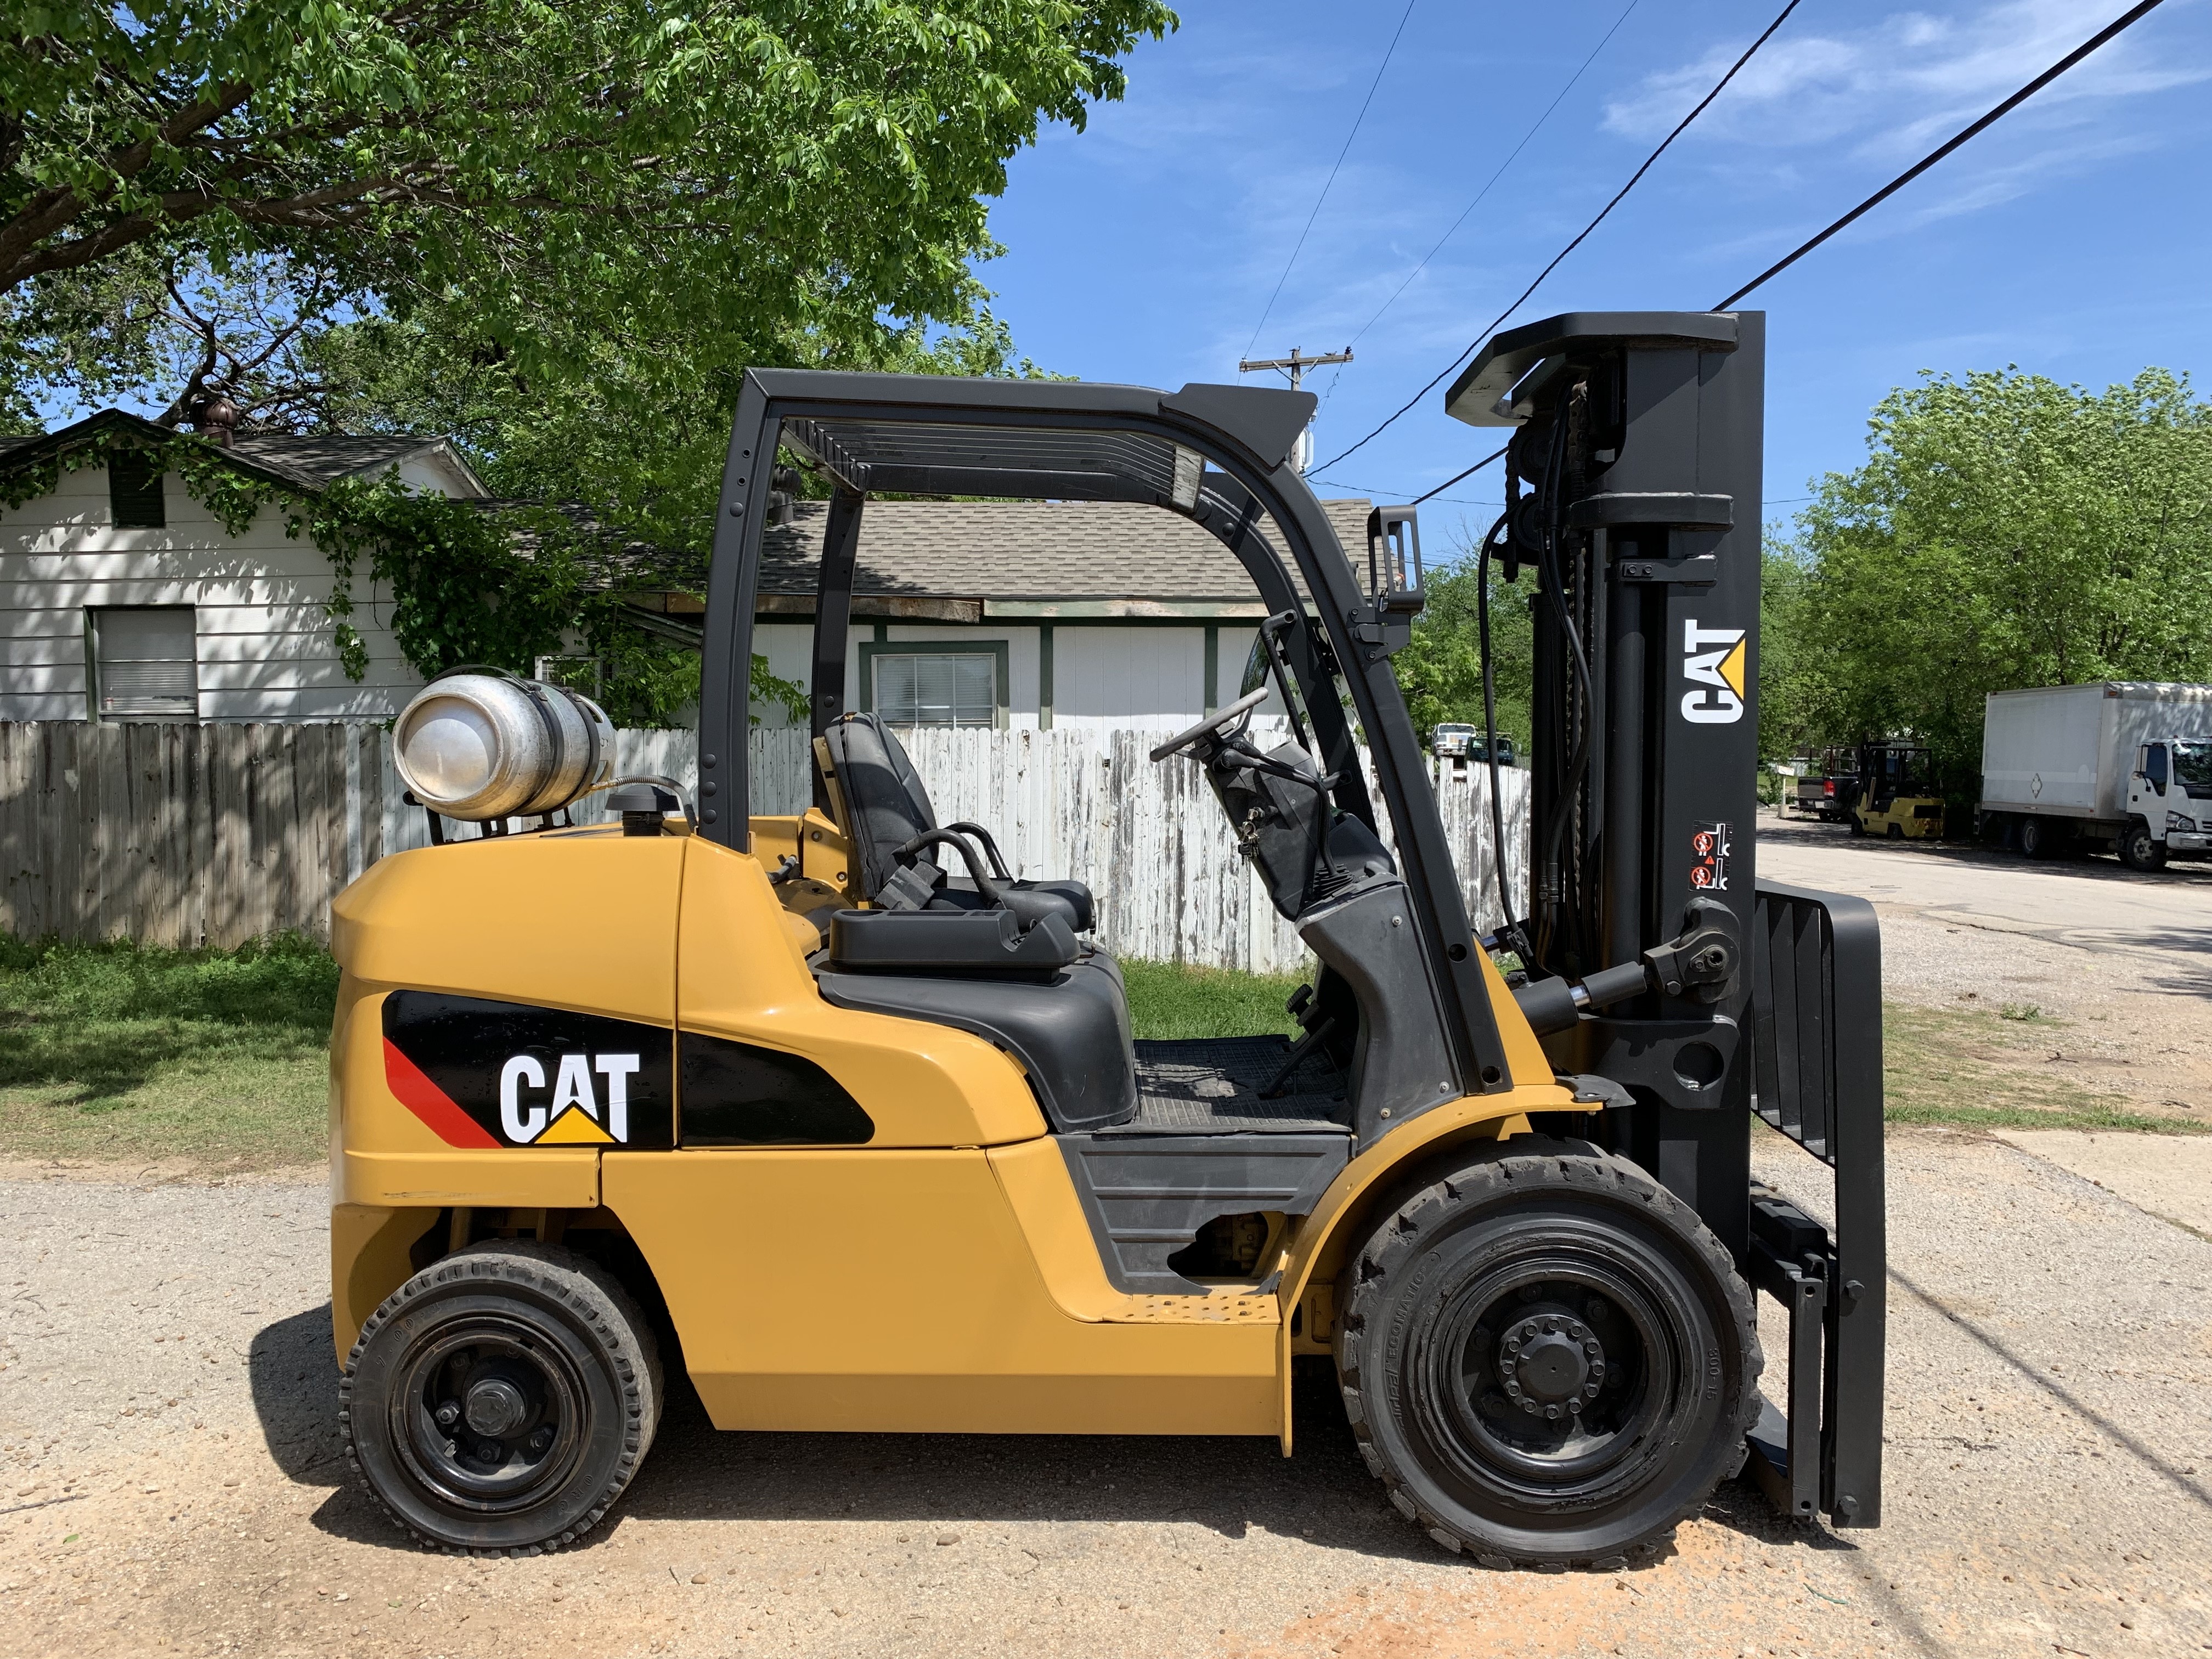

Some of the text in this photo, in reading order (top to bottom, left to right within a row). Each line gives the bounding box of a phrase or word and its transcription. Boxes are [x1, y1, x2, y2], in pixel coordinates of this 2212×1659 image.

[1681, 619, 1746, 724] CAT
[500, 1054, 640, 1143] CAT
[1706, 1347, 1720, 1401] 300-15
